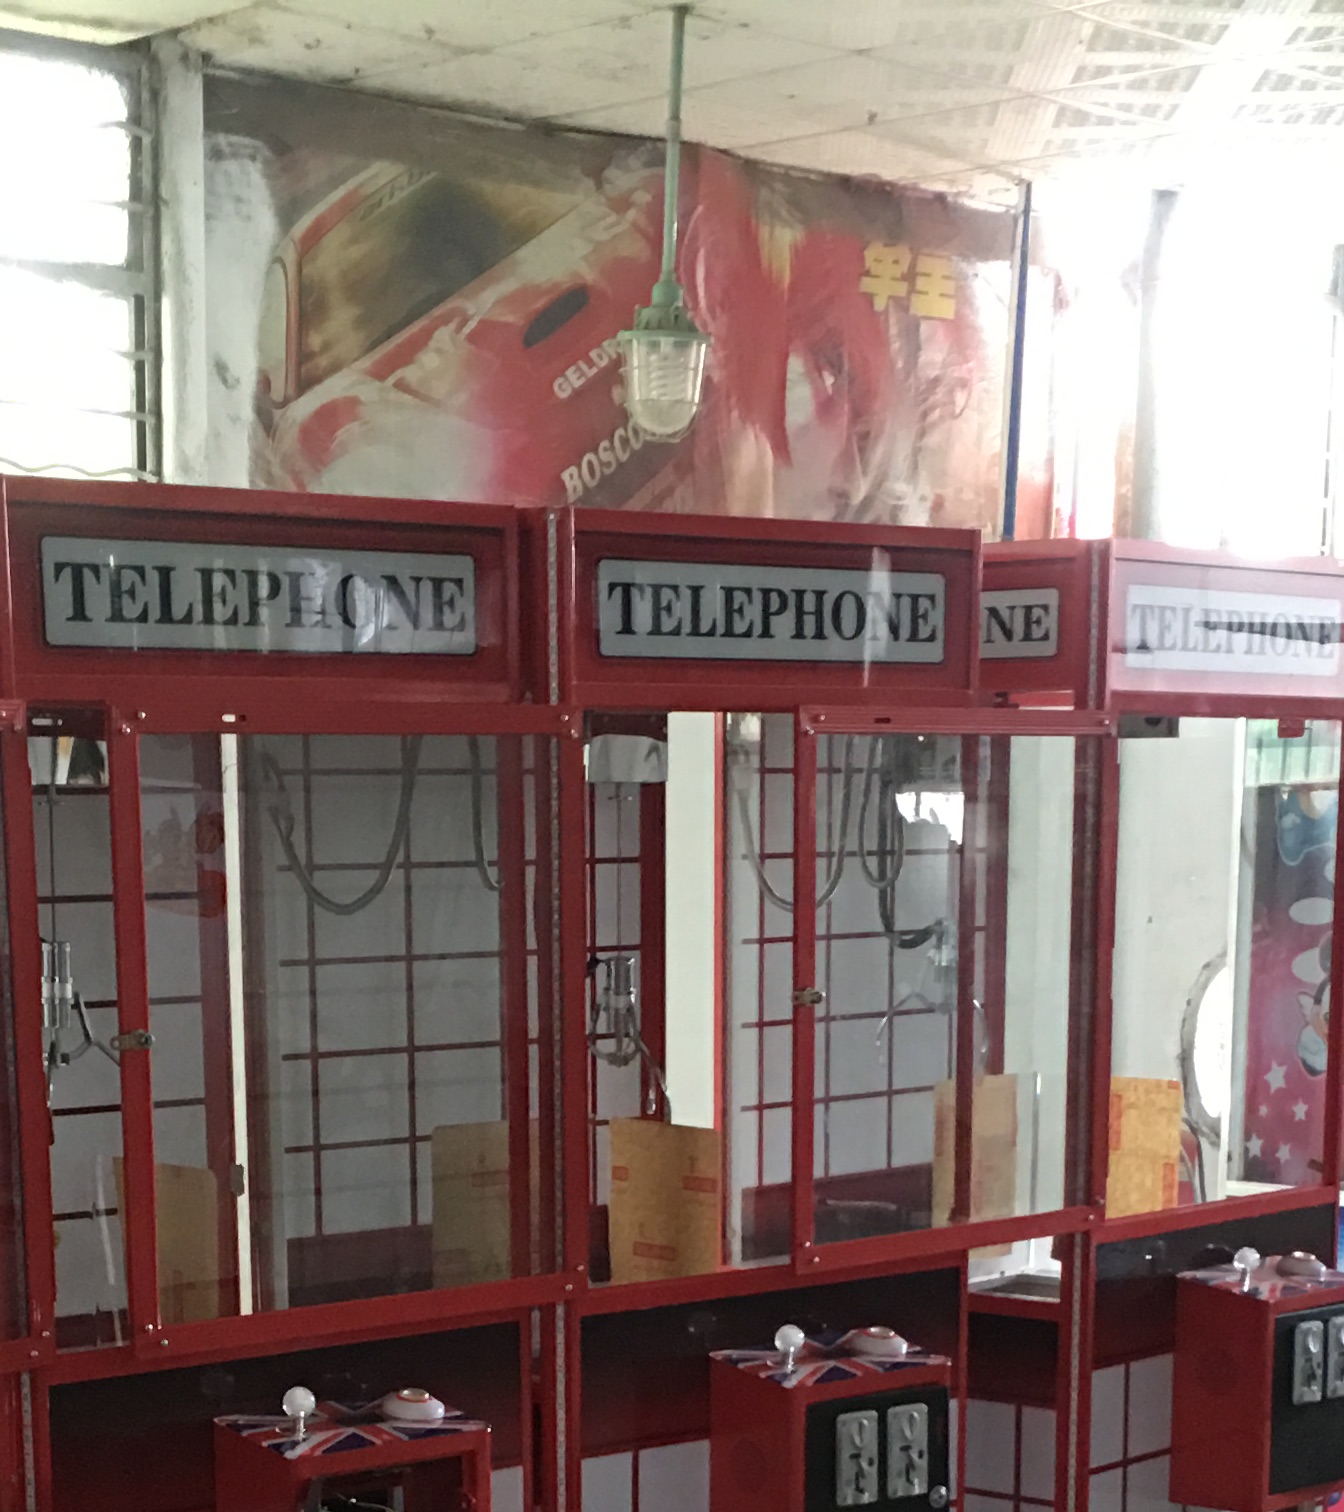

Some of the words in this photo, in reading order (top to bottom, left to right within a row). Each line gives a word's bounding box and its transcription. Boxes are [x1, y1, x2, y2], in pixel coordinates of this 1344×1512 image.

[53, 560, 467, 633] TELEPHONE
[608, 581, 940, 644] TELEPHONE
[1130, 602, 1339, 660] TELEPHONE
